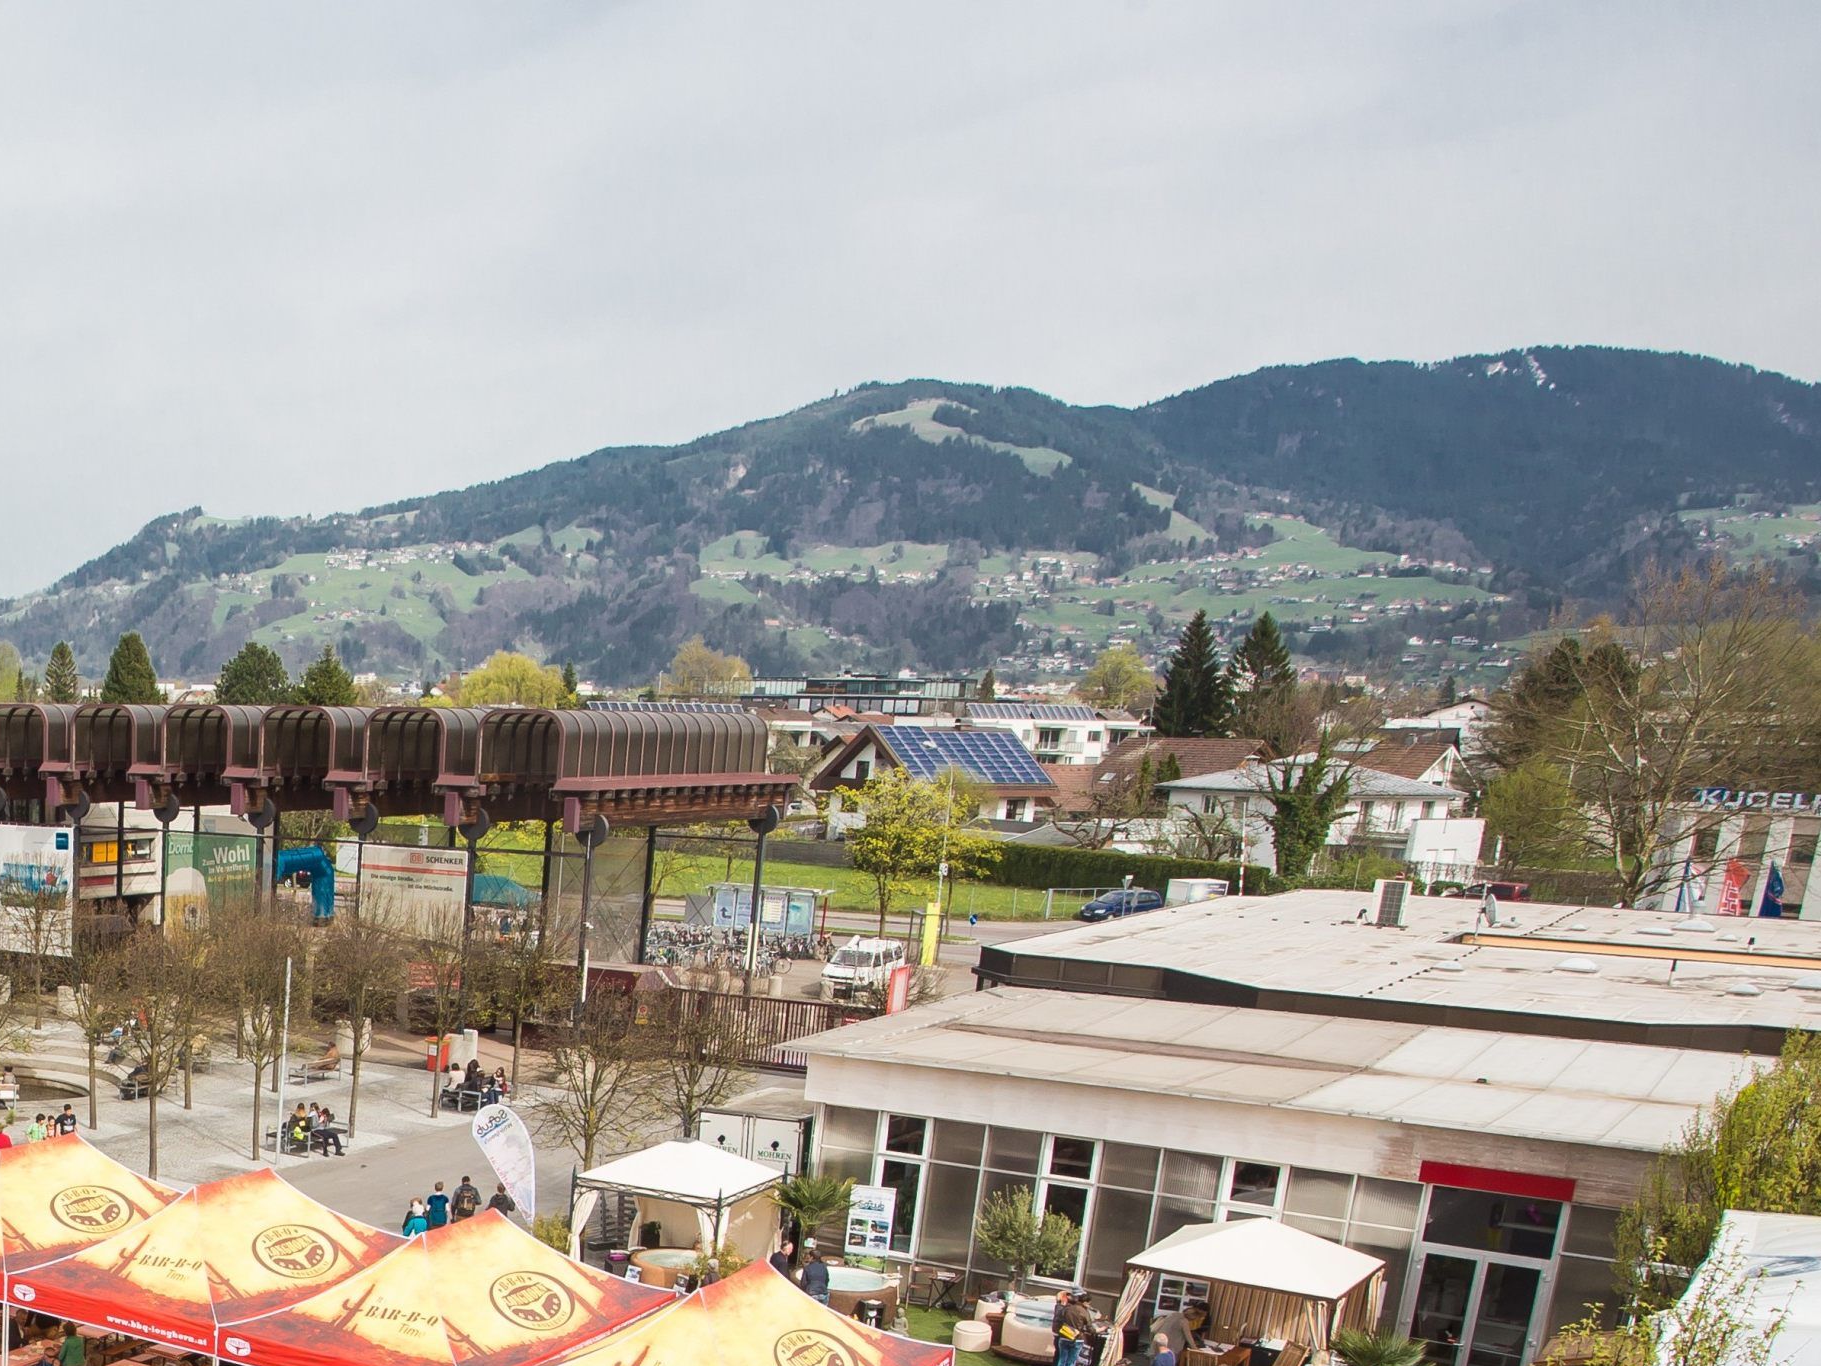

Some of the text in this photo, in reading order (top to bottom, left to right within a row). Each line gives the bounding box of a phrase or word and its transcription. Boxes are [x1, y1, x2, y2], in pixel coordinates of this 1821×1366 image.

[214, 845, 250, 864] Wohl
[411, 854, 464, 866] DB SCHENKER
[757, 1150, 792, 1160] MOHREN
[138, 1254, 202, 1272] BAR-B-Q
[364, 1306, 440, 1327] BAR-B-Q
[106, 1314, 208, 1347] www.bbq-longhorn.at
[398, 1322, 428, 1338] Time
